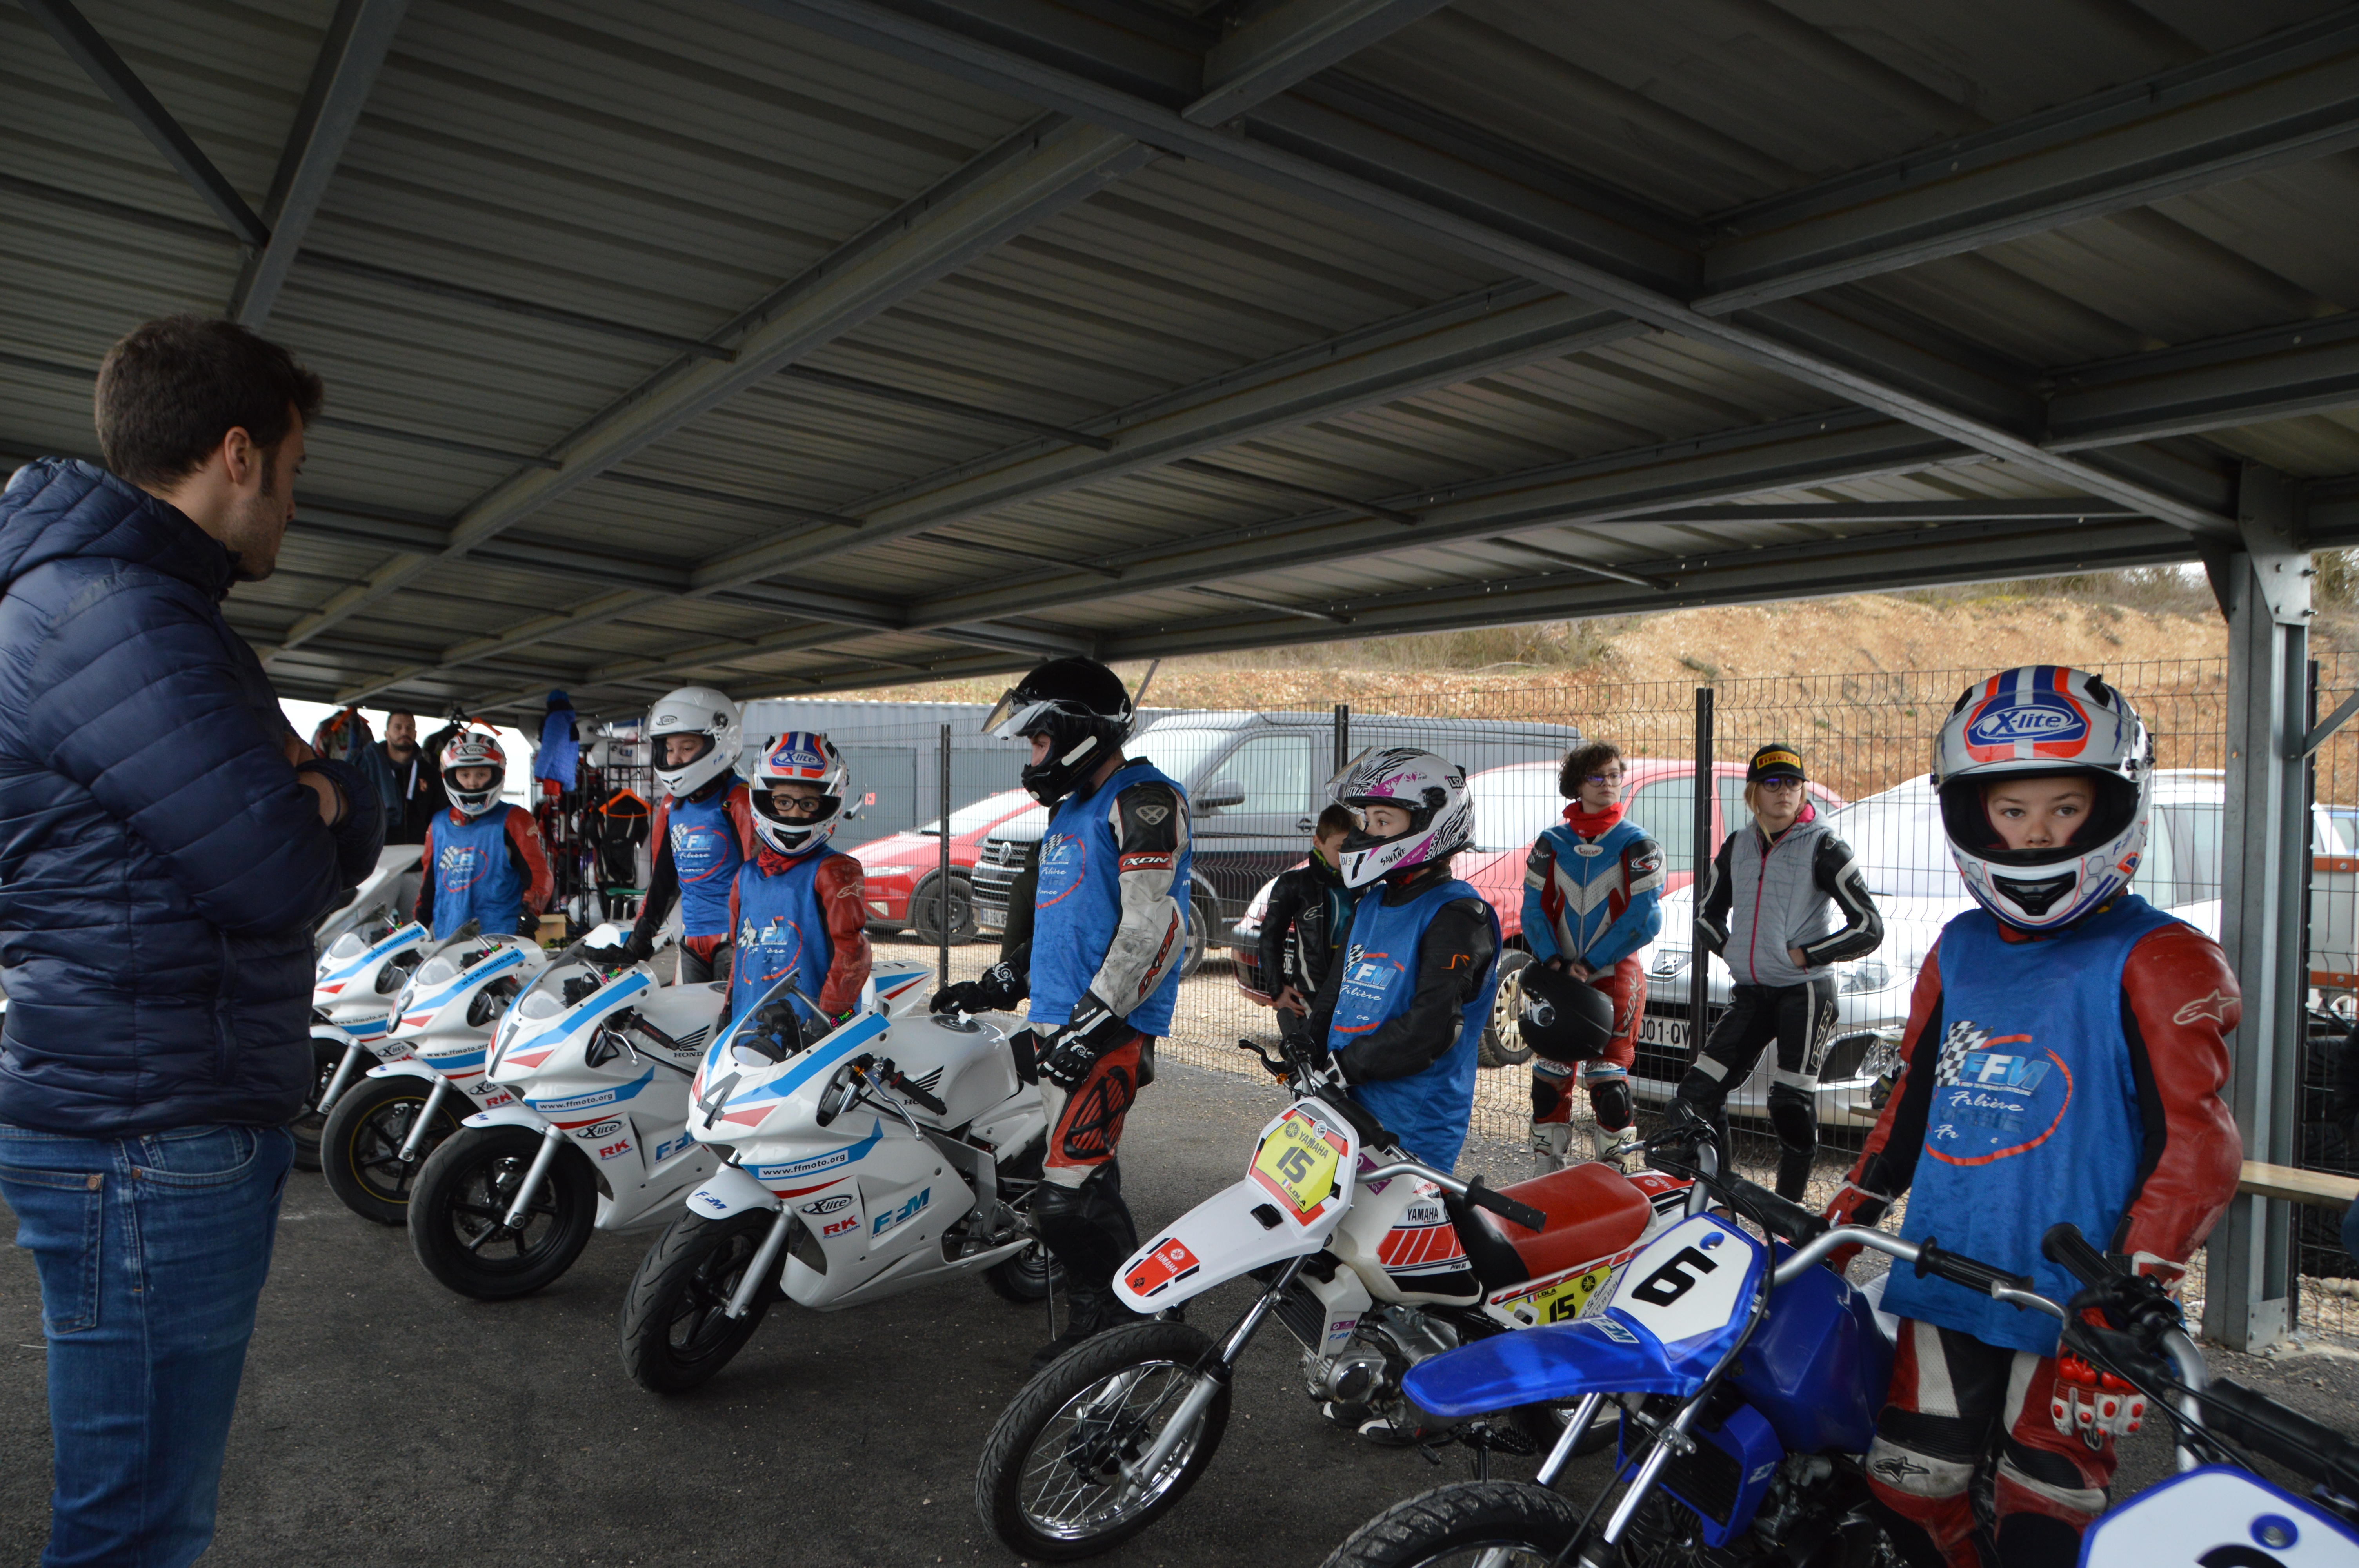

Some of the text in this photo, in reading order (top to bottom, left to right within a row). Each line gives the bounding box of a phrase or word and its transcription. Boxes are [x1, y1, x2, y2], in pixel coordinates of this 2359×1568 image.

[1986, 711, 2062, 736] X-lite
[784, 752, 816, 763] X-lite
[1448, 777, 1463, 788] LS2
[1380, 847, 1406, 867] SAVANE
[462, 951, 520, 985] www.ffmoto.org
[1346, 962, 1397, 987] FFM
[1339, 985, 1382, 1000] Filière
[1957, 1052, 2051, 1091] FFM
[540, 1093, 612, 1109] www.ffmoto.org
[697, 1071, 742, 1131] 4
[583, 1123, 617, 1138] X-lite
[599, 1138, 630, 1157] RK
[1299, 1131, 1329, 1159] YAMAHA
[763, 1154, 845, 1176] www.ffmoto.org
[1276, 1147, 1315, 1184] 15
[811, 1198, 847, 1214] X-lite
[1289, 1186, 1306, 1207] LOLA
[872, 1186, 931, 1235] FFM
[1408, 1207, 1438, 1221] YAMAHA
[823, 1215, 858, 1235] RK
[843, 1224, 860, 1235] CHAIN
[1155, 1251, 1178, 1274] YAMAHA
[1631, 1246, 1719, 1307] 6
[1537, 1288, 1556, 1298] LOLA
[1587, 1300, 1594, 1310] St
[1594, 1275, 1613, 1300] Sauveur
[1601, 1296, 1607, 1305] 39
[1607, 1288, 1612, 1296] 25
[1612, 1281, 1619, 1289] 04
[1549, 1293, 1576, 1323] 15
